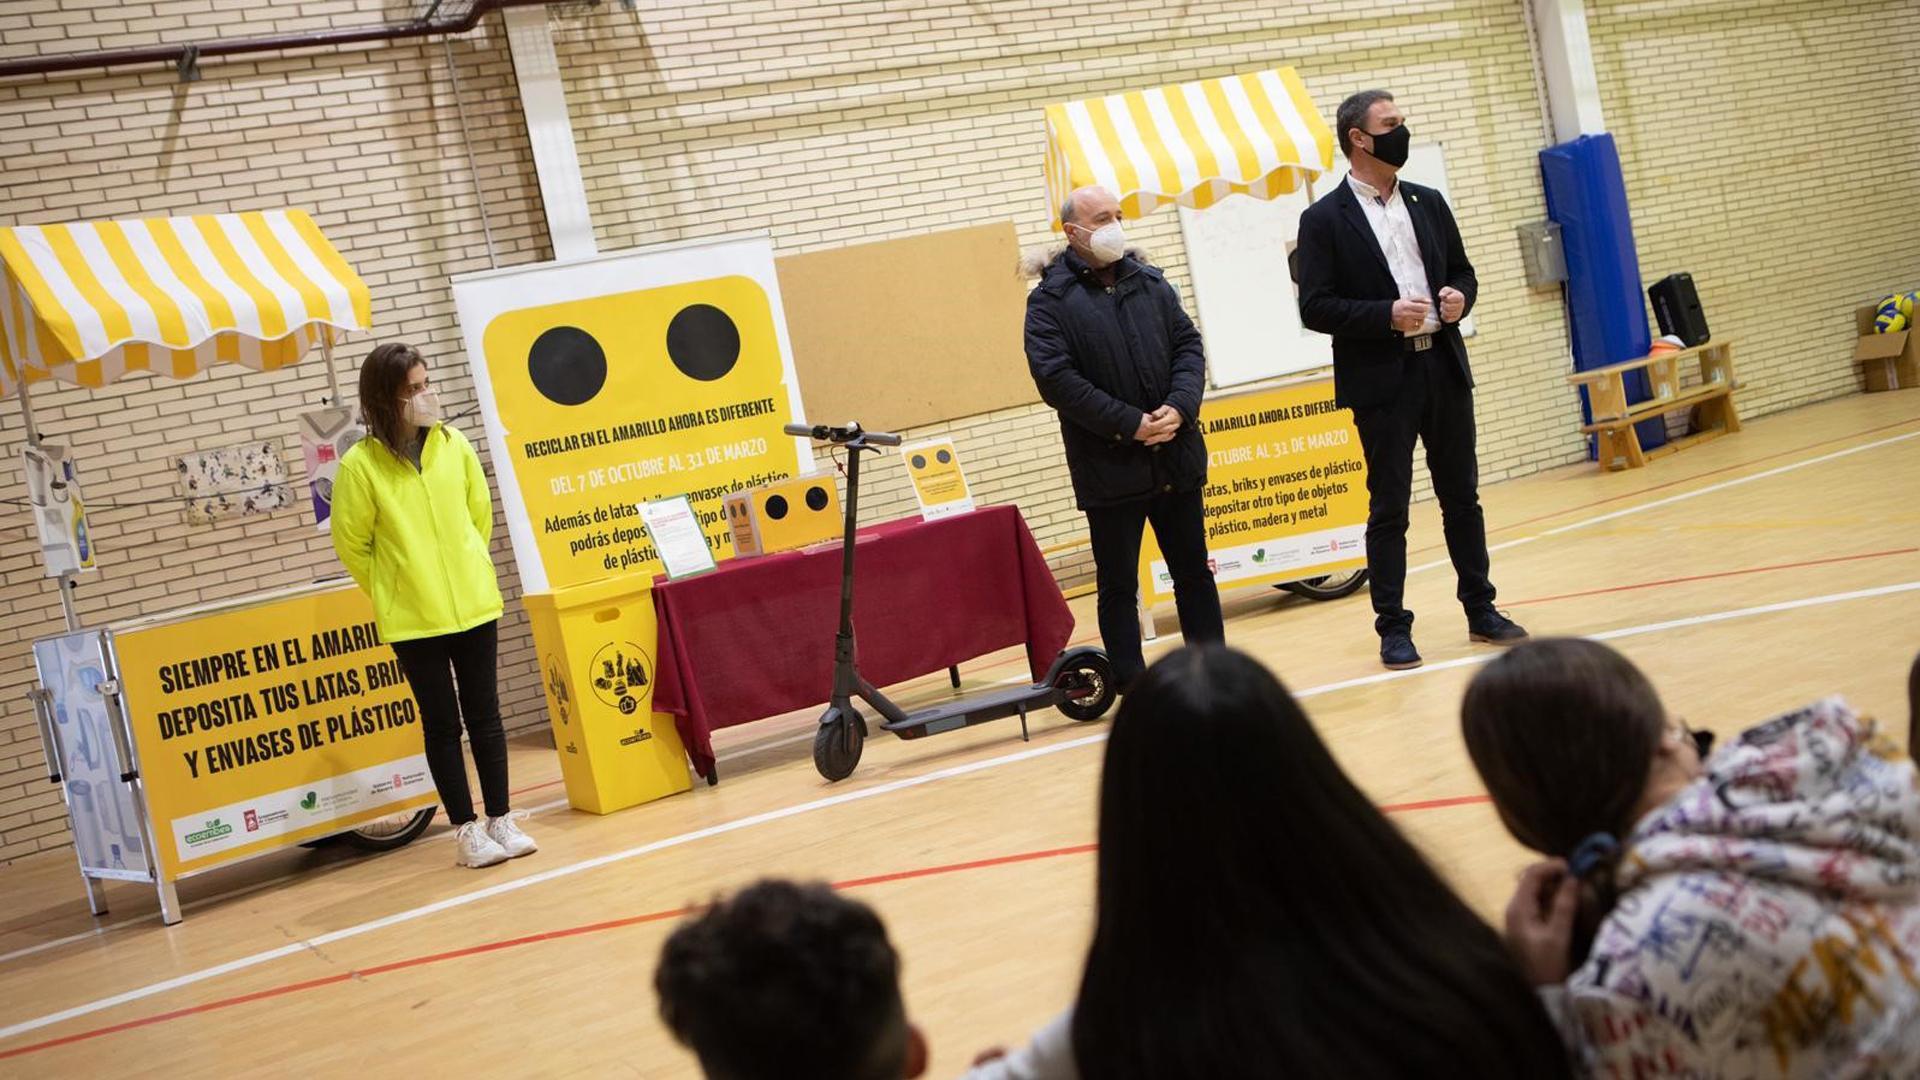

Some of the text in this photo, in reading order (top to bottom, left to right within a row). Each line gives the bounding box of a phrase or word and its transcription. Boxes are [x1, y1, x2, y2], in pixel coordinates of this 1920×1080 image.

[524, 398, 776, 459] RECICLAR EN EL AMARILLO AHORA ES DIFERENTE
[1209, 413, 1257, 434] AMARILLO
[1258, 408, 1290, 425] AHORA
[1291, 405, 1304, 419] ES
[1256, 443, 1271, 459] AL
[1273, 442, 1288, 458] 31
[1291, 436, 1306, 453] DE
[1307, 429, 1349, 450] MARZO
[550, 437, 767, 495] DEL 7 DE OCTUBRE AL 31 DE MARZO
[1232, 477, 1258, 493] briks
[1259, 477, 1266, 490] y
[1268, 470, 1308, 487] envases
[1309, 465, 1322, 479] de
[1324, 459, 1363, 479] plástico
[544, 510, 592, 534] Además
[593, 506, 609, 523] de
[609, 502, 640, 519] latas
[1204, 481, 1349, 519] depositar otro tipo de objetos
[1209, 519, 1251, 540] plástico,
[1252, 511, 1290, 529] madera
[1291, 510, 1298, 524] y
[1299, 503, 1328, 521] metal
[570, 530, 611, 556] podrás
[604, 553, 619, 570] de
[620, 544, 660, 570] plástic
[158, 621, 388, 694] SIEMPRE EN EL AMARIL
[157, 692, 258, 741] DEPOSITA
[259, 683, 300, 716] TUS
[302, 668, 366, 707] LATAS,
[183, 697, 417, 779] Y ENVASES DE PLÁSTICO
